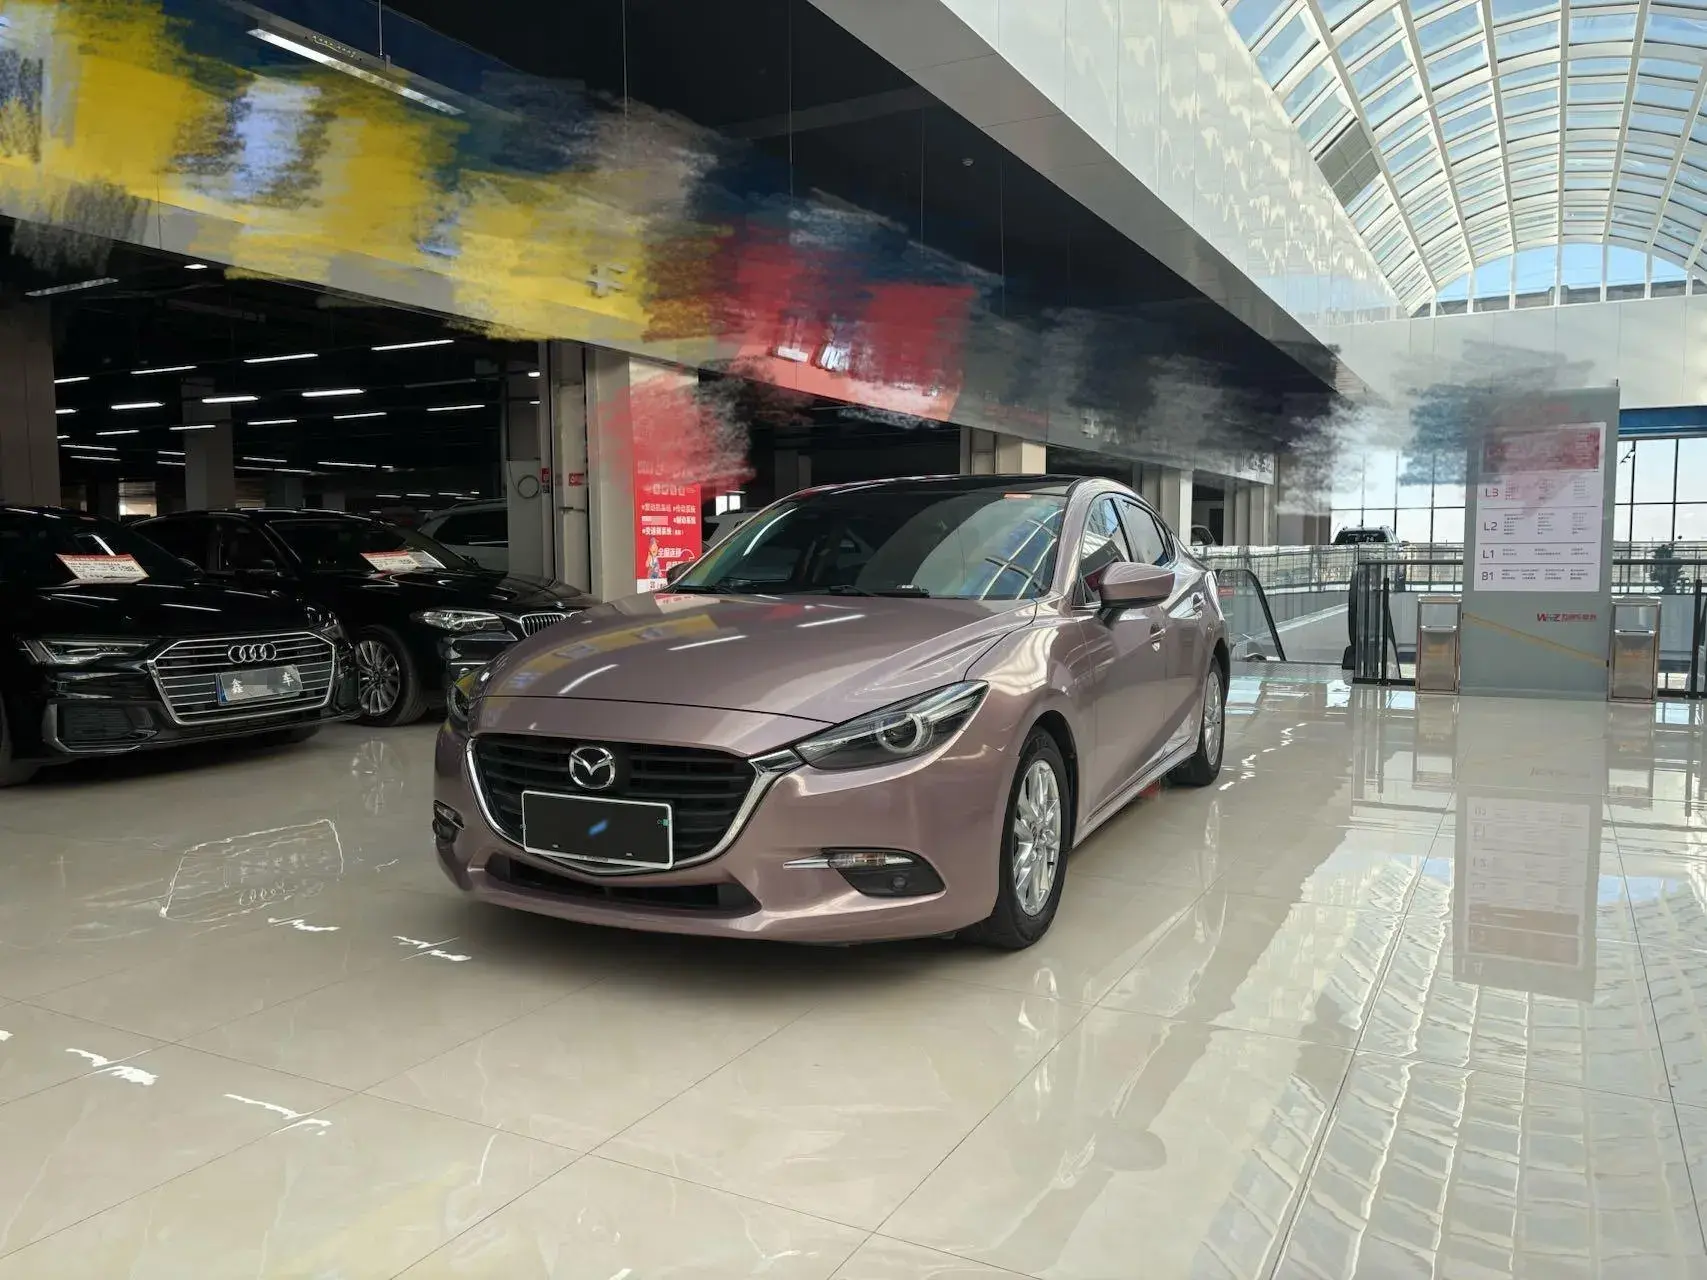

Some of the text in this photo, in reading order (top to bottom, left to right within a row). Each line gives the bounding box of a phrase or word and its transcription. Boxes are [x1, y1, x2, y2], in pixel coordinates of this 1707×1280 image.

[1485, 488, 1499, 498] L3
[1484, 521, 1498, 531] L2
[1482, 549, 1494, 559] L1
[1481, 571, 1494, 581] B1
